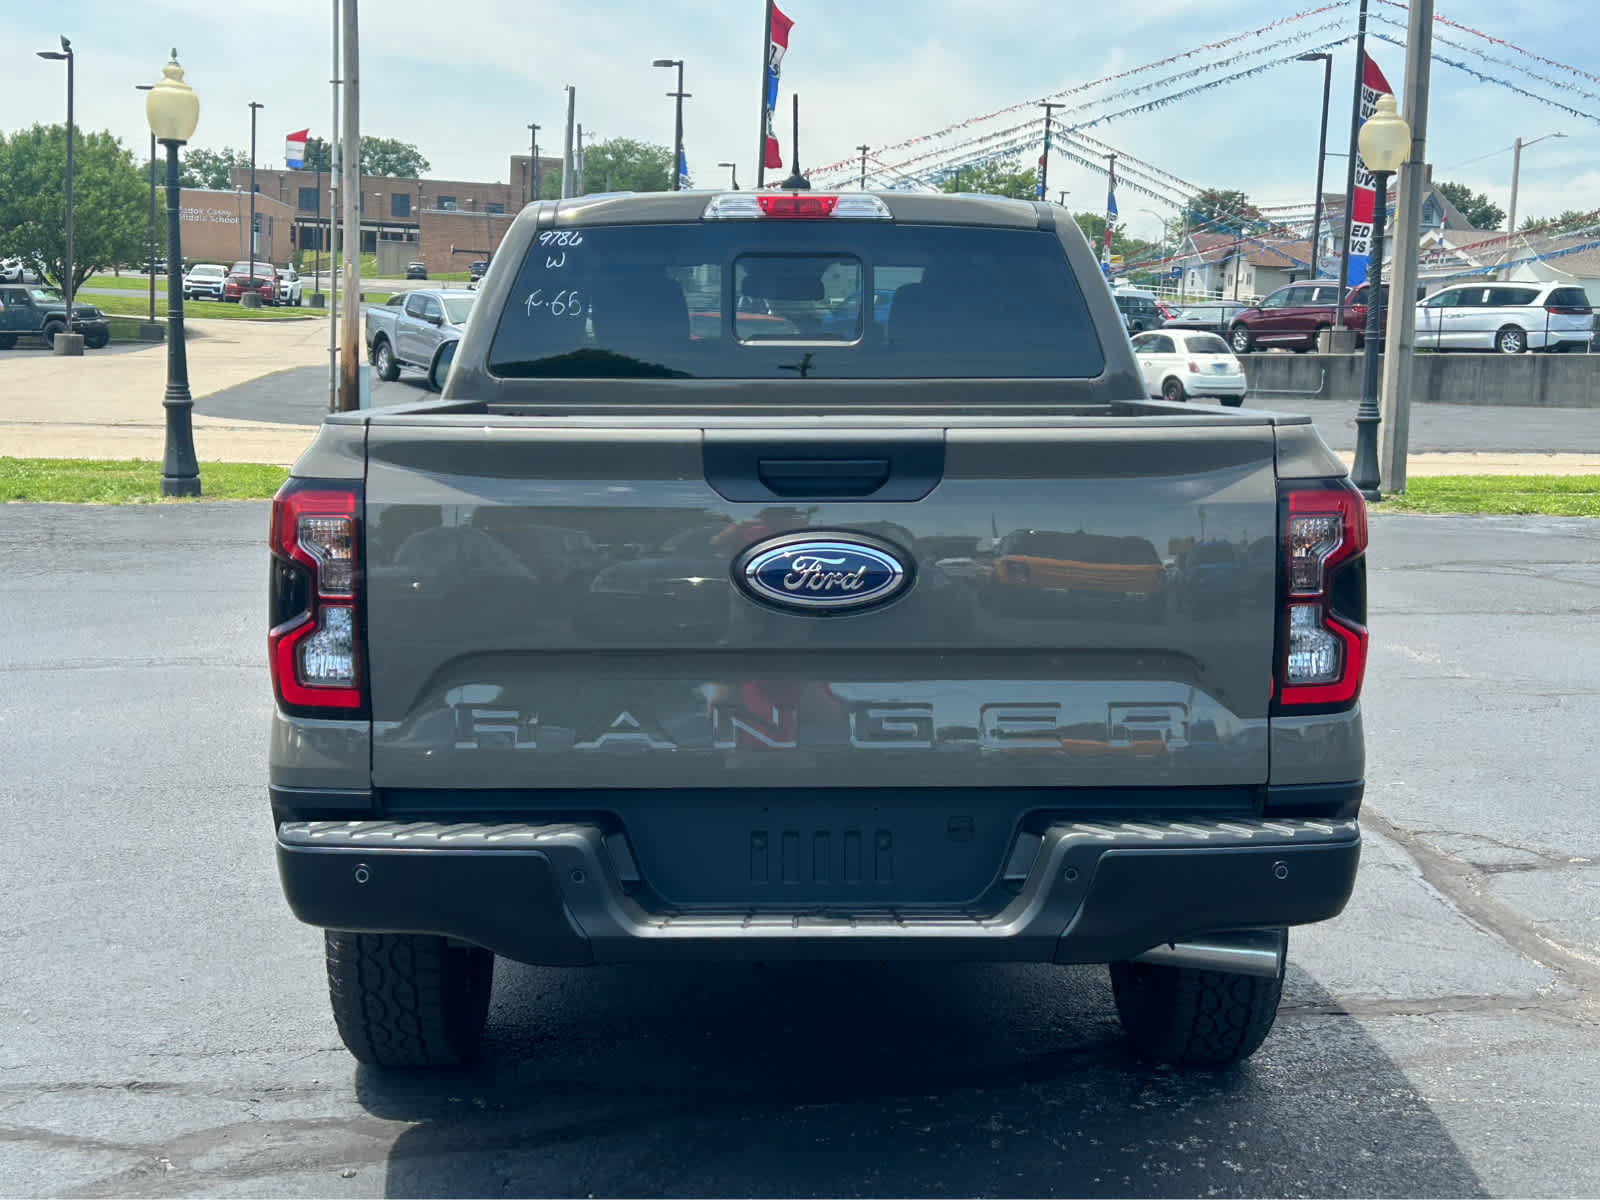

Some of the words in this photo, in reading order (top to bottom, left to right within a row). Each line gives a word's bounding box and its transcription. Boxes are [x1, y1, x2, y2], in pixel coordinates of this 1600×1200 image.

[539, 230, 583, 247] 9786
[1352, 225, 1370, 238] ED
[783, 554, 867, 591] Ford
[453, 701, 1191, 750] RANGER
